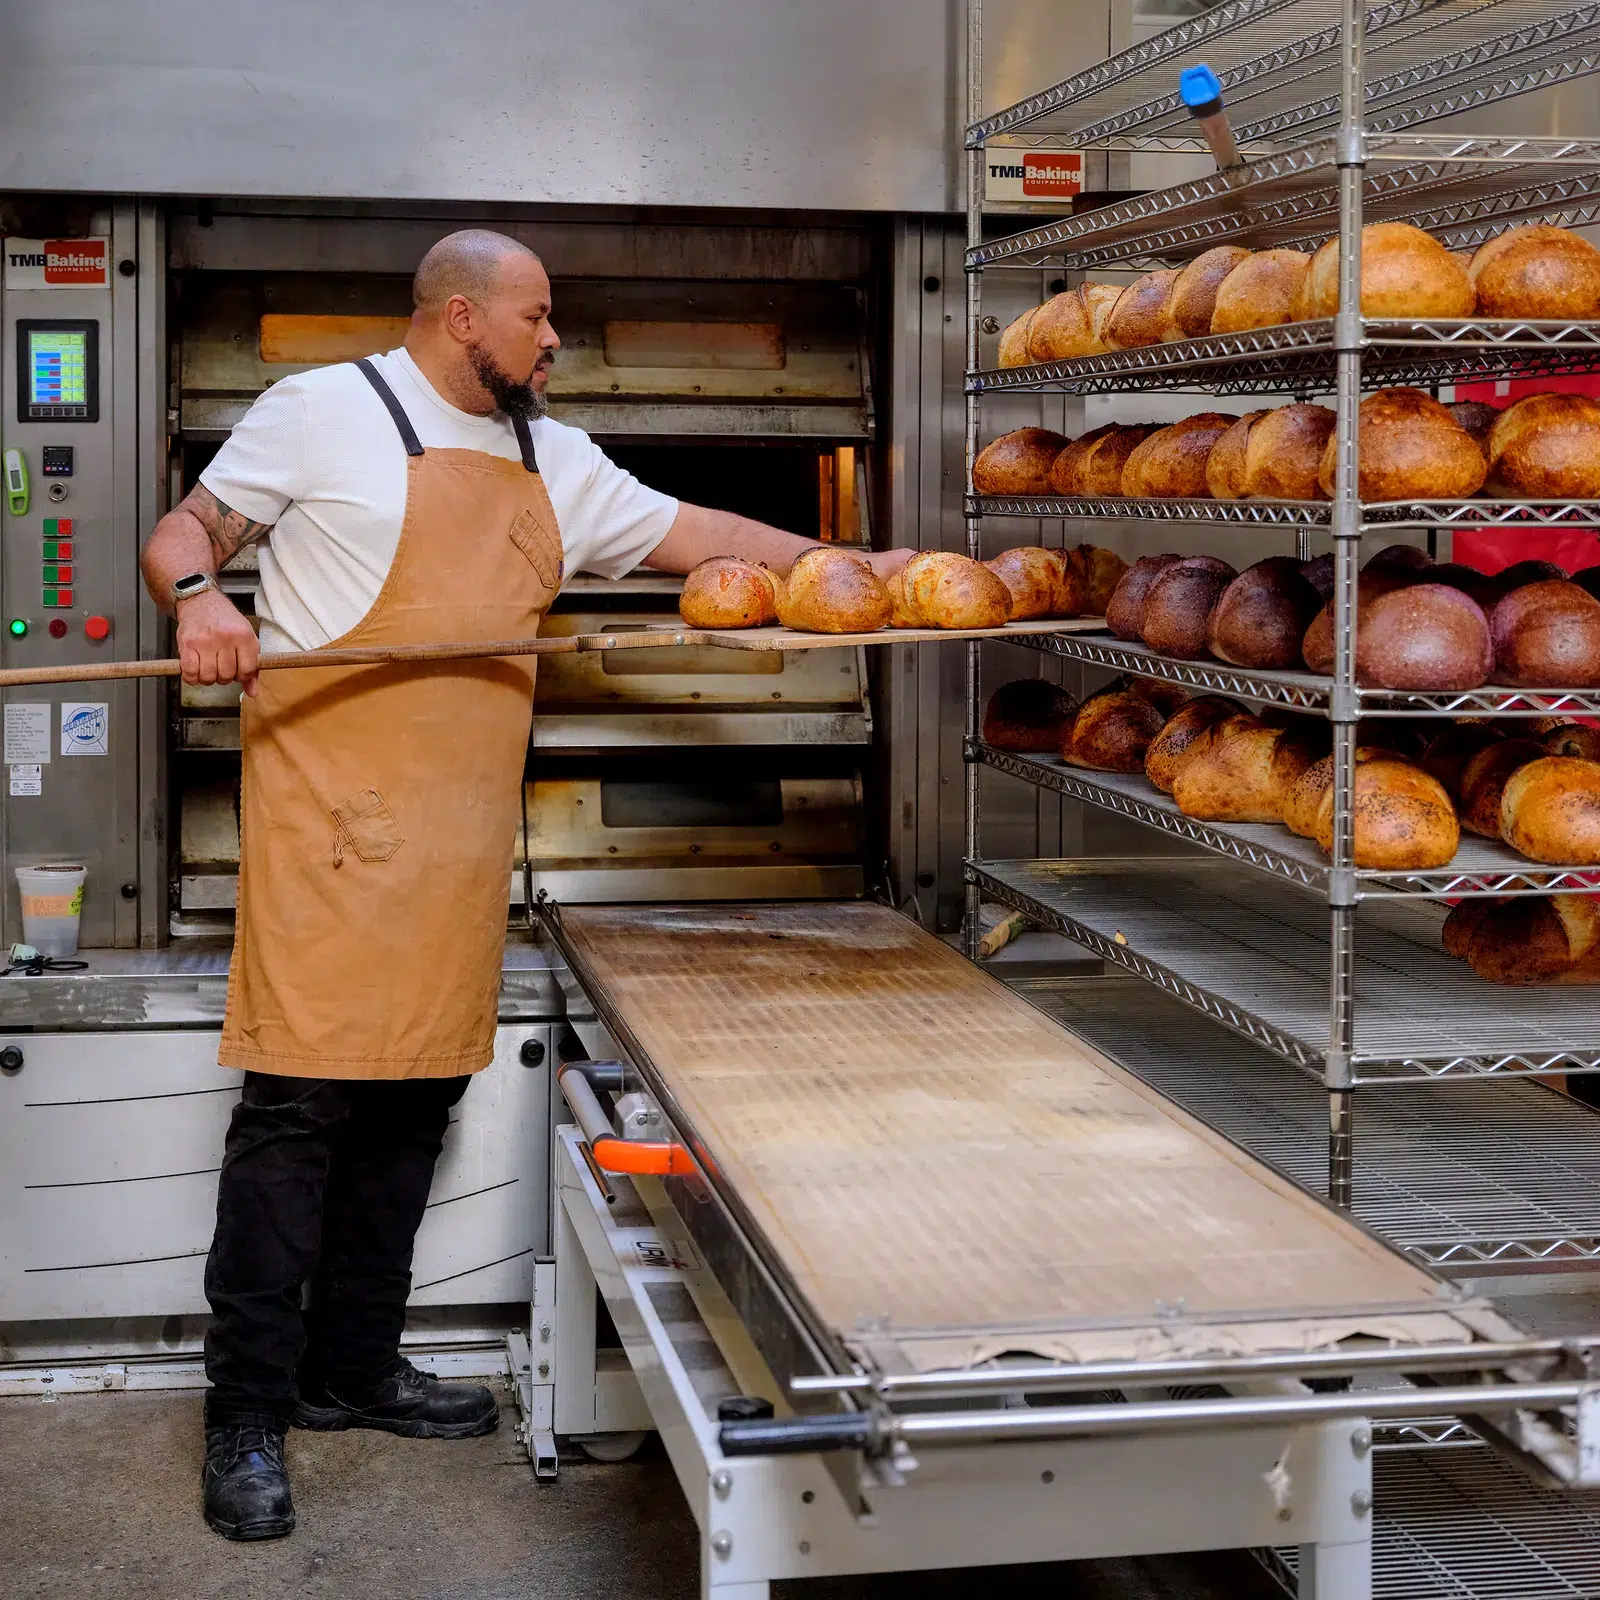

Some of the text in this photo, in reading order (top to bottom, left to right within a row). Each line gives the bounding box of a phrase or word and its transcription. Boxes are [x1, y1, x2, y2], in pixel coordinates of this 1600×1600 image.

[989, 165, 1081, 183] TMB Baking
[9, 253, 106, 269] TMB Baking
